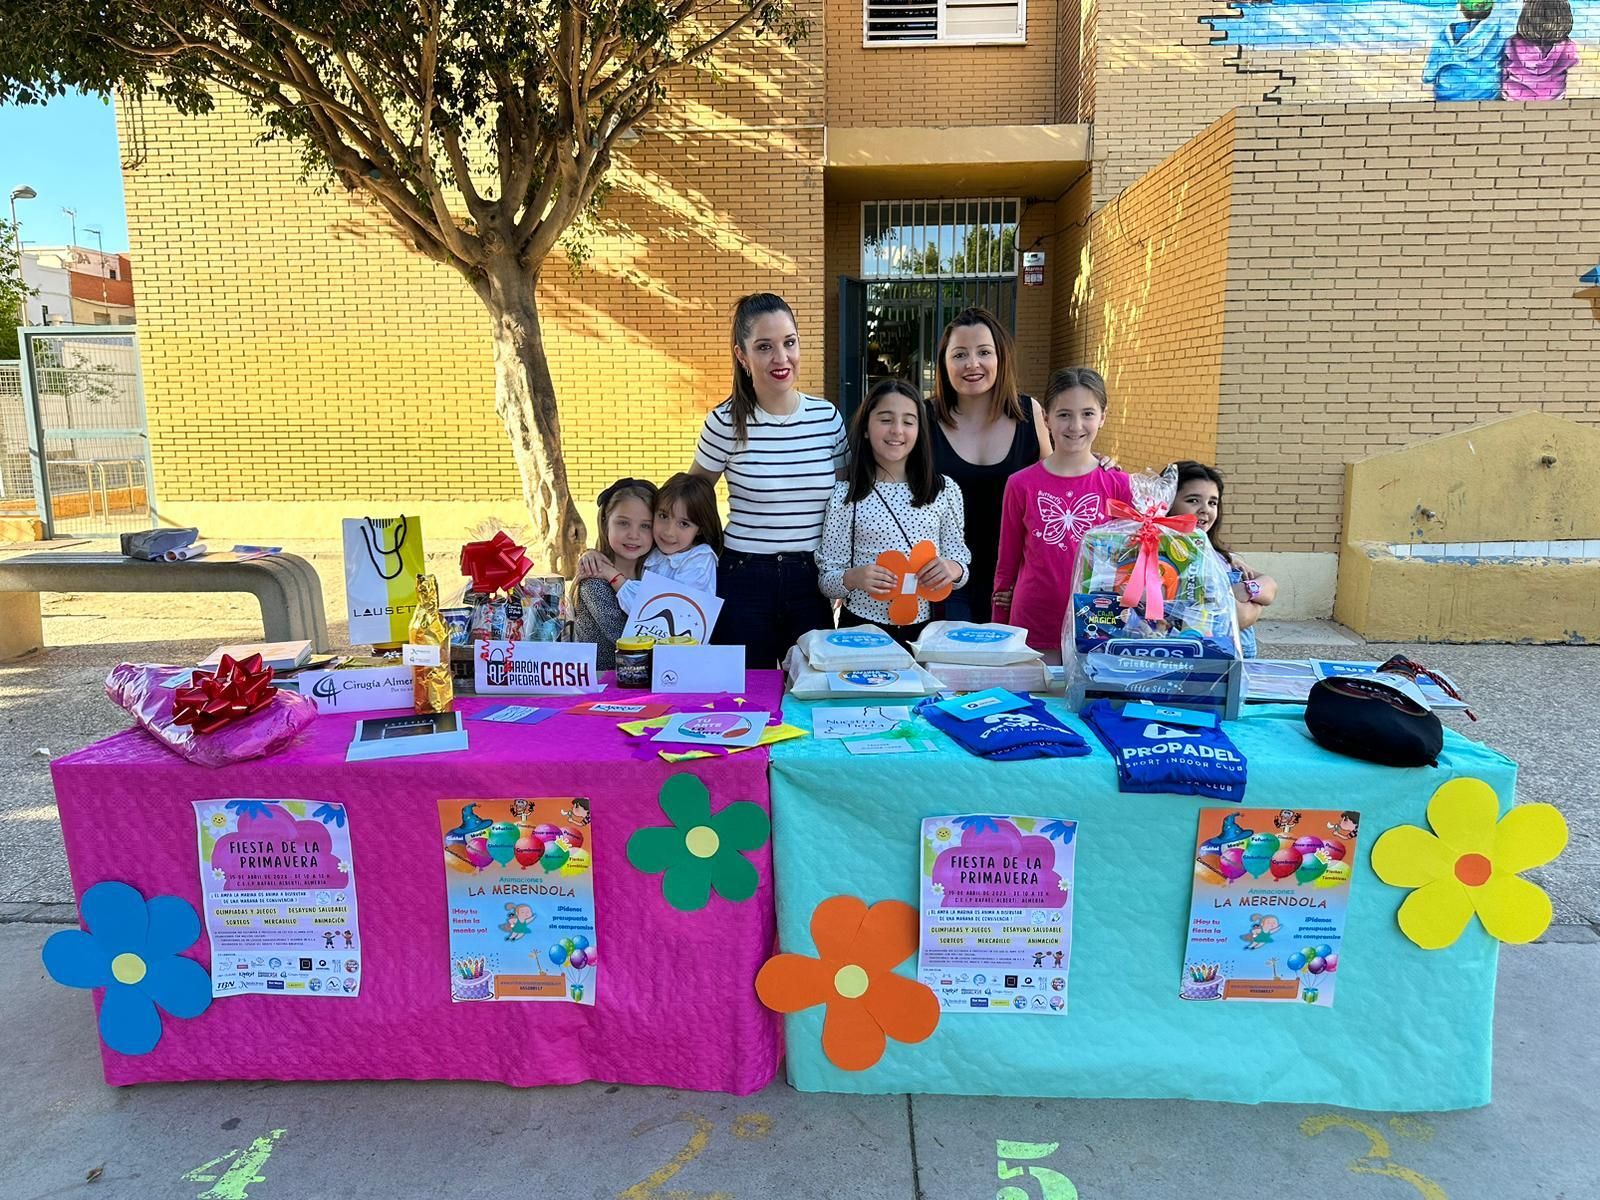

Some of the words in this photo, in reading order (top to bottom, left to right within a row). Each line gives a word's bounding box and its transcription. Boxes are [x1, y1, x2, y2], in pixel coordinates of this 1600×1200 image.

[1038, 490, 1062, 504] Butterfly
[509, 675, 540, 686] PIEDRA
[541, 662, 589, 686] CASH
[343, 678, 380, 692] Cirugía
[1122, 742, 1240, 762] PROPADEL
[1126, 759, 1160, 768] SPORT
[1166, 758, 1209, 768] INDOOR
[1216, 762, 1243, 771] CLUB
[230, 842, 274, 854] FIESTA
[282, 841, 296, 853] DE
[305, 841, 320, 853] LA
[240, 856, 318, 868] PRIMAVERA
[951, 856, 995, 868] FIESTA
[1003, 857, 1018, 869] DE
[1027, 857, 1042, 870] LA
[961, 871, 1038, 885] PRIMAVERA
[468, 887, 485, 896] LA
[492, 884, 575, 897] MERENDOLA
[1214, 898, 1232, 908] LA
[1239, 896, 1327, 909] MERENDOLA
[180, 1128, 288, 1200] 4
[995, 1139, 1078, 1200] 5
